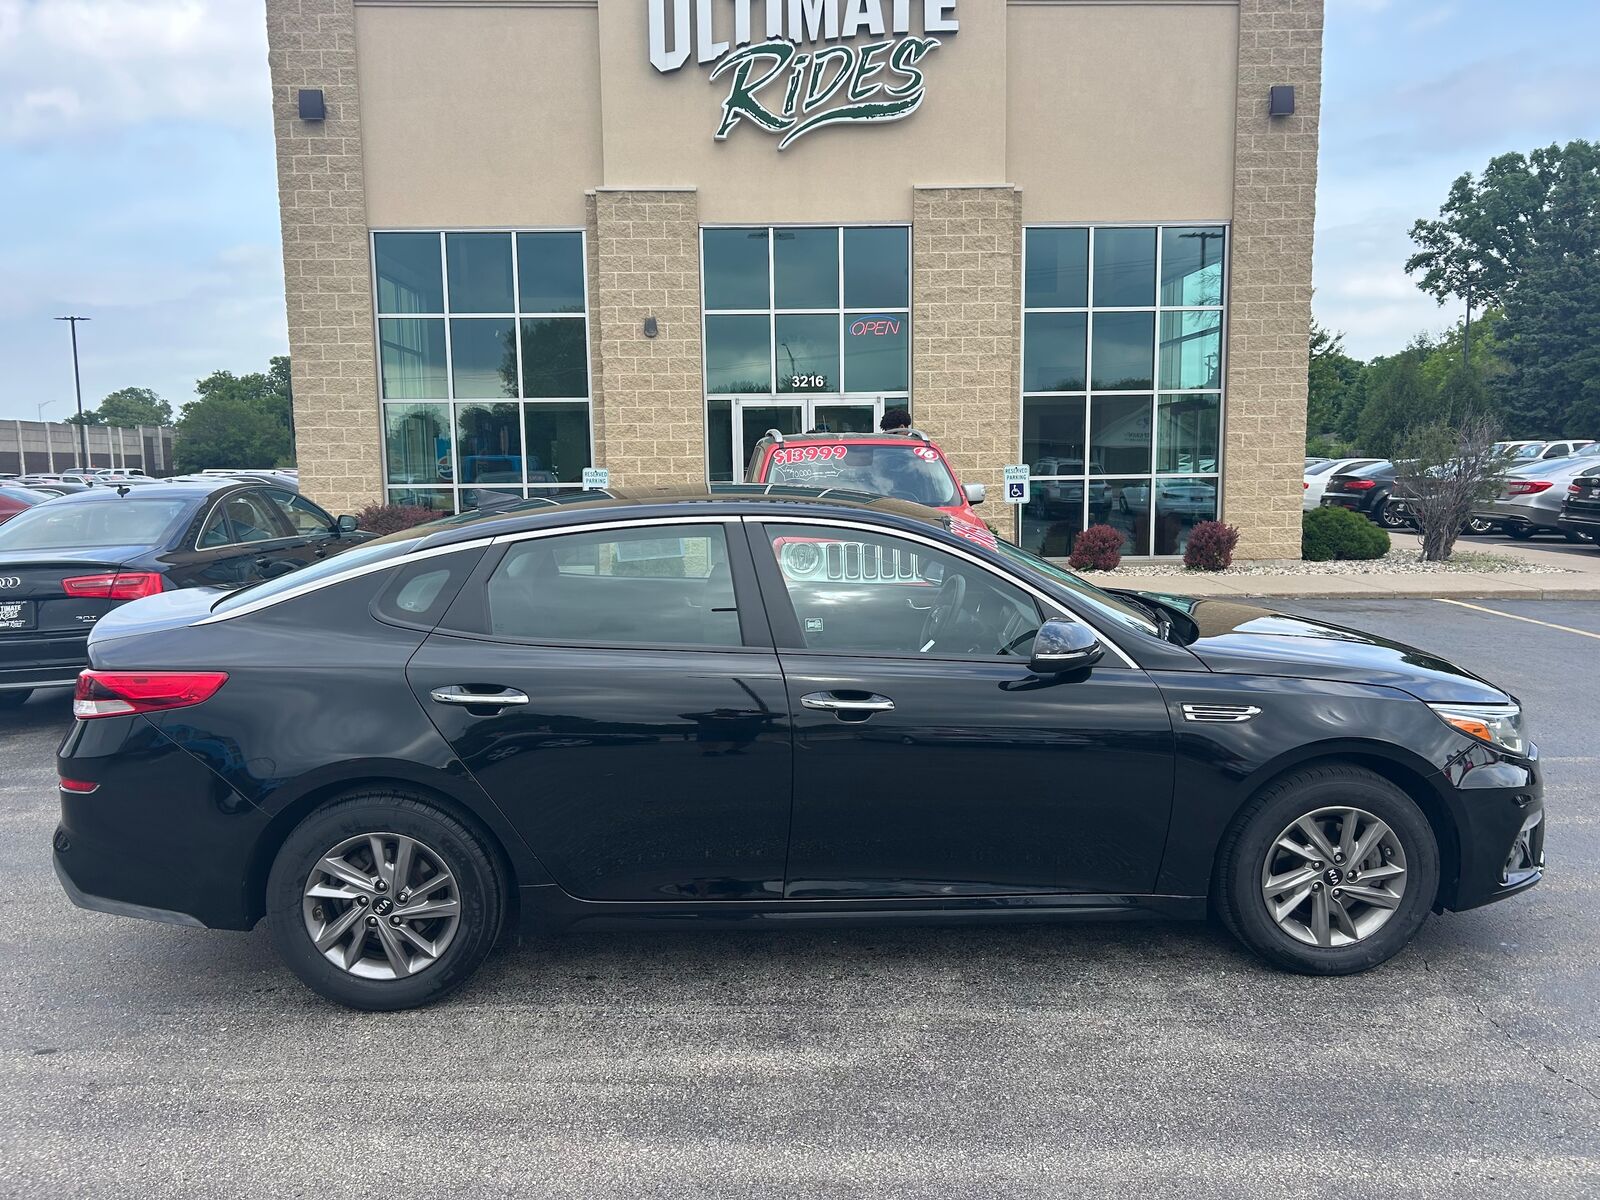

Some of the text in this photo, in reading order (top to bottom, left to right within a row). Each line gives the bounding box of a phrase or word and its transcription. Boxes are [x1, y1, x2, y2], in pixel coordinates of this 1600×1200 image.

[851, 320, 901, 336] OPEN
[791, 375, 824, 388] 3216
[773, 445, 848, 465] $13999
[1328, 869, 1339, 885] KIA
[374, 899, 391, 914] KIA
